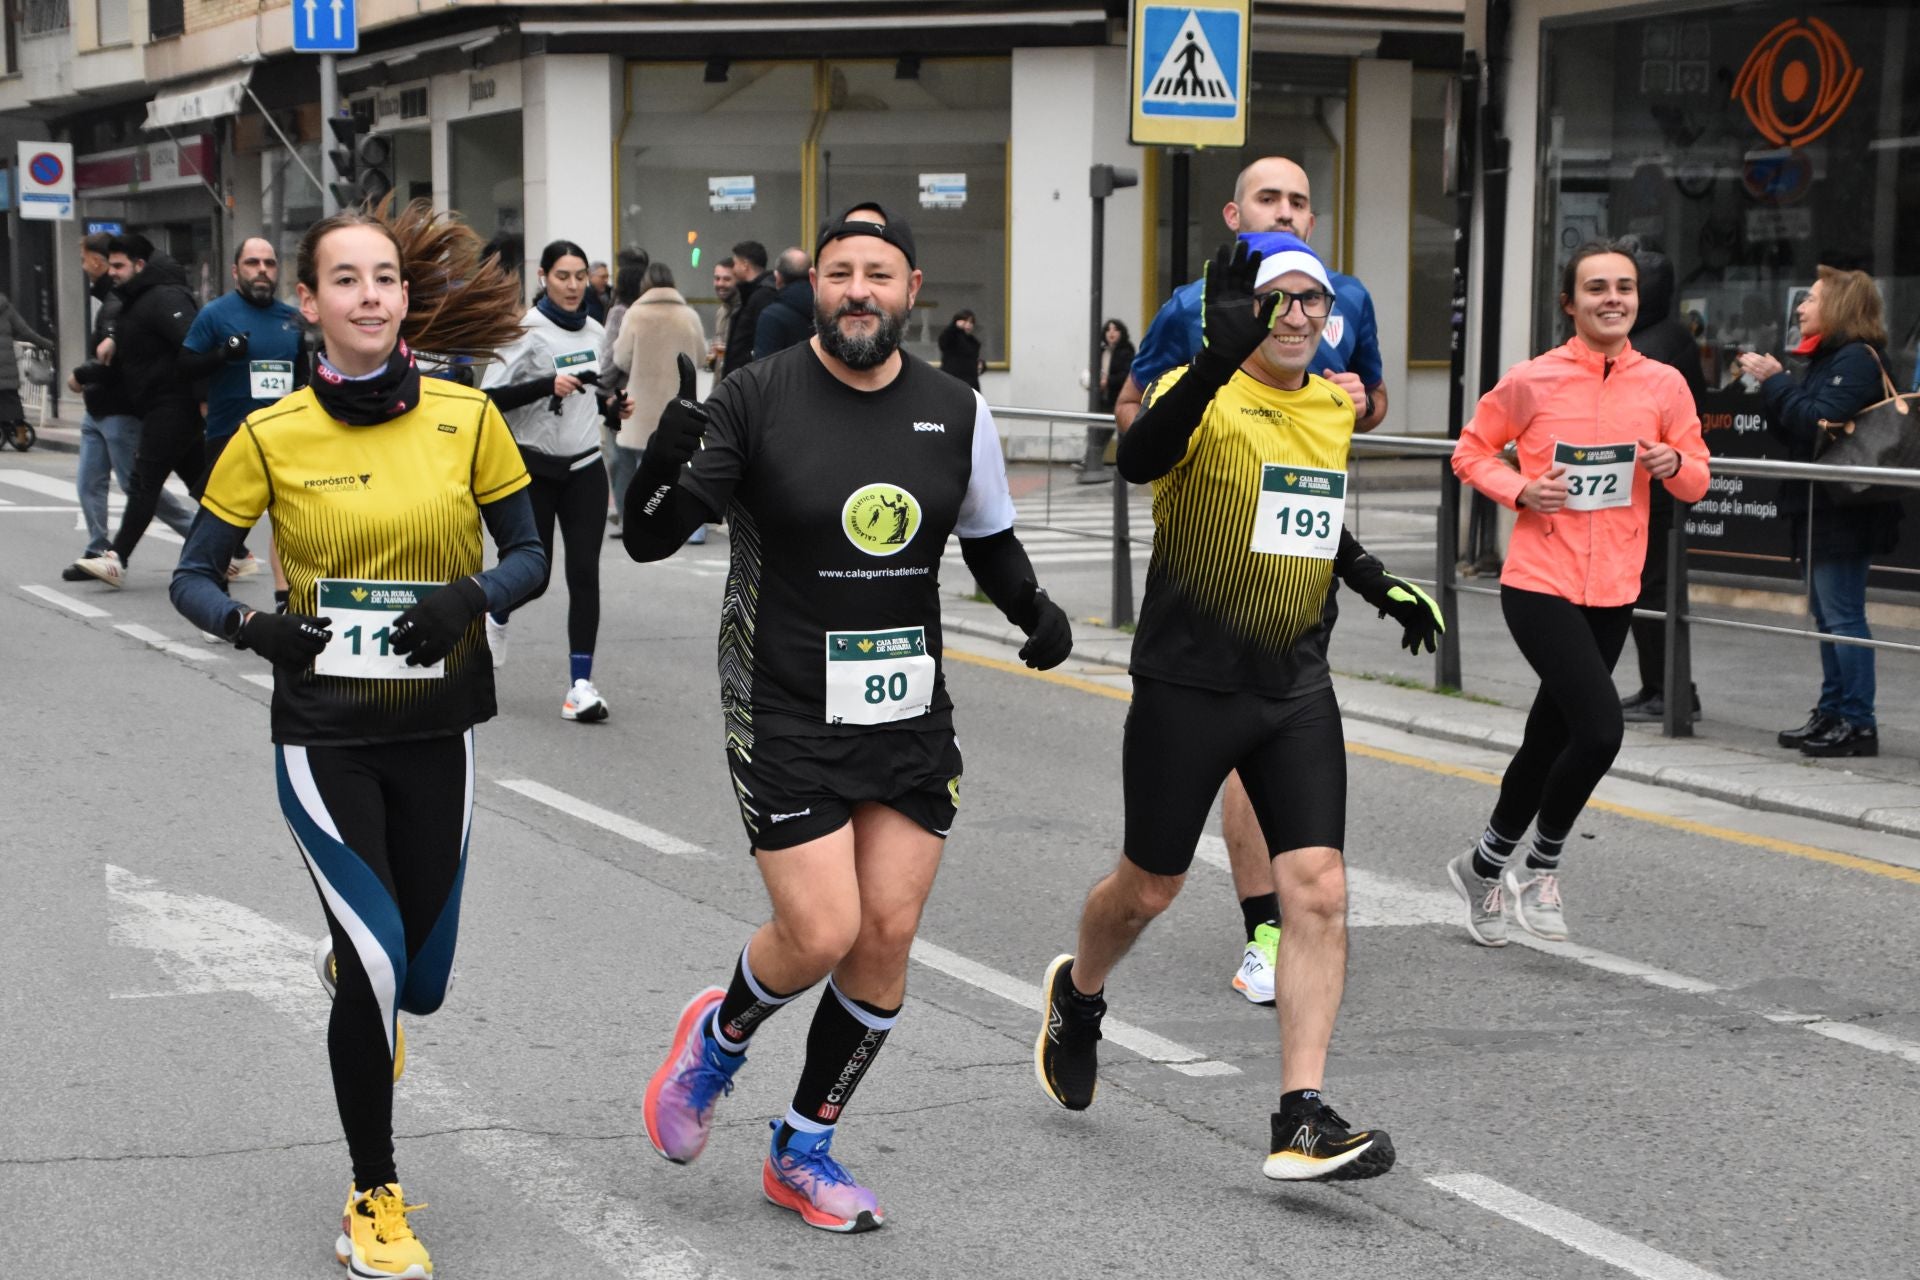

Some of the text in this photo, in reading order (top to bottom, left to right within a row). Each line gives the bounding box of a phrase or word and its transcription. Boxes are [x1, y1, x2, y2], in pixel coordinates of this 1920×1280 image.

[260, 377, 286, 390] 421
[1240, 406, 1282, 418] PROPÓSITO
[1702, 412, 1732, 433] guro
[1734, 414, 1761, 434] que
[304, 475, 356, 488] PROPÓSITO
[1568, 473, 1618, 496] 372
[1708, 475, 1743, 495] tología
[1720, 498, 1732, 513] de
[1733, 499, 1742, 514] la
[1744, 501, 1778, 519] miopía
[1276, 506, 1330, 538] 193
[1698, 520, 1724, 536] visual
[370, 596, 382, 604] DE
[371, 590, 415, 598] CAJA RURAL
[300, 622, 330, 640] KIPST
[344, 625, 390, 656] 11
[864, 672, 908, 704] 80
